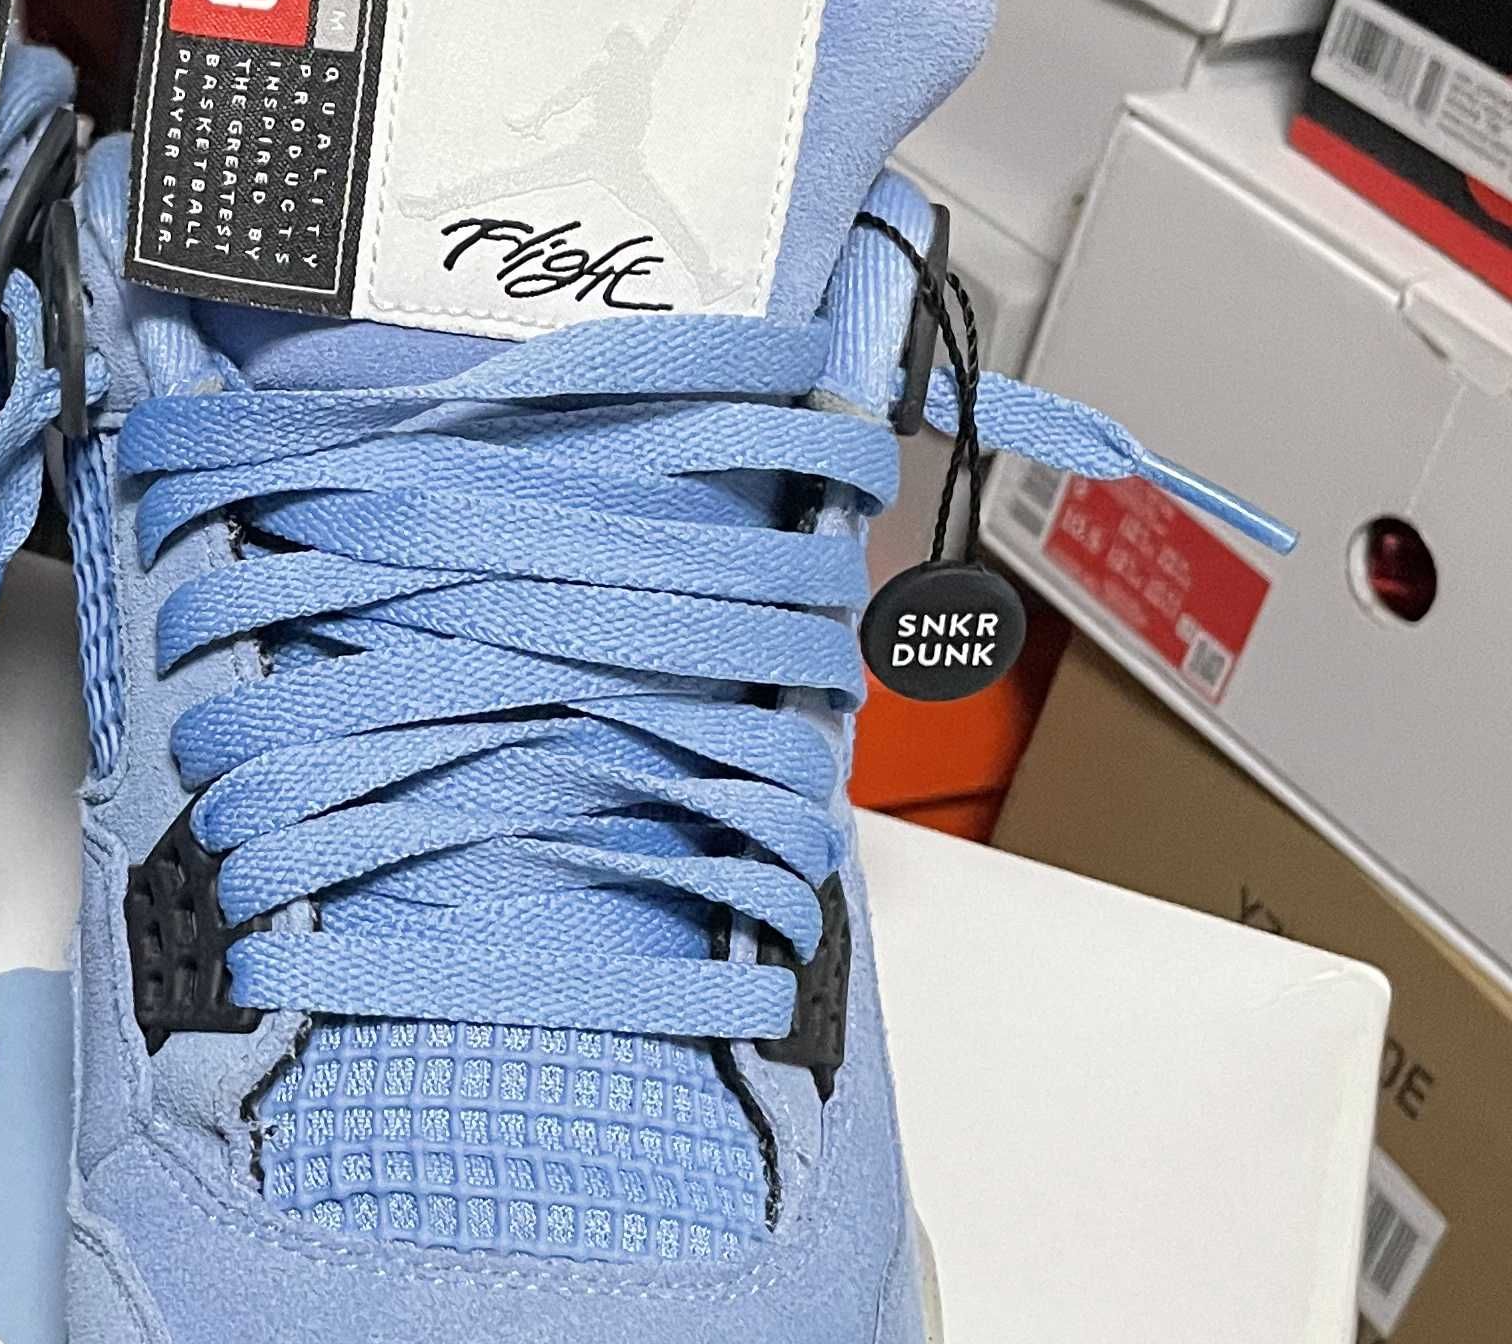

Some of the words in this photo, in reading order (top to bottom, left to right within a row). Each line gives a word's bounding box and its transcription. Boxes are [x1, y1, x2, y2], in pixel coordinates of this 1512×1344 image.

[164, 48, 191, 159] PLAYER
[230, 59, 252, 110] THE
[252, 60, 281, 205] INSPIRED
[185, 53, 221, 249] BASKETBALL
[213, 120, 243, 256] GREATEST
[274, 64, 312, 265] PRODUCTS
[301, 66, 341, 269] QUALITY
[243, 227, 262, 261] BY
[441, 217, 674, 311] Flight
[891, 642, 996, 667] DUNK
[897, 612, 1000, 638] SNKR
